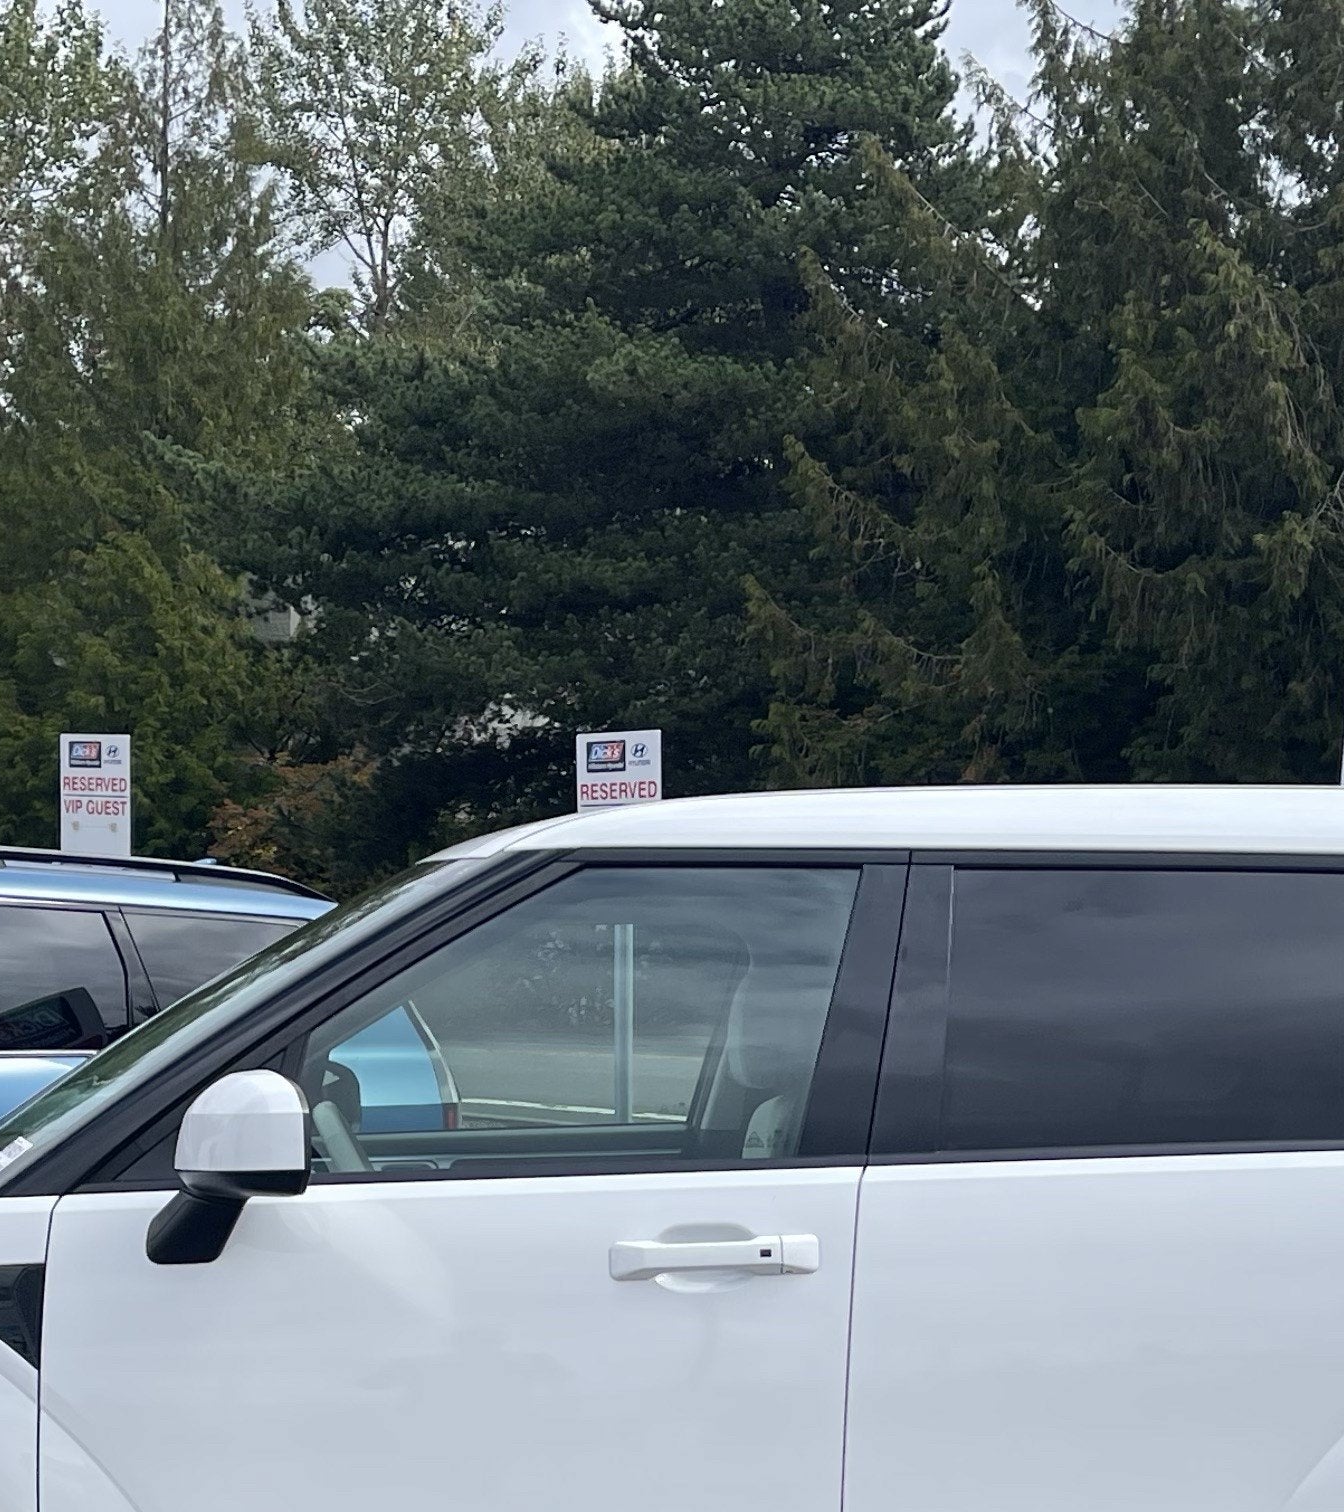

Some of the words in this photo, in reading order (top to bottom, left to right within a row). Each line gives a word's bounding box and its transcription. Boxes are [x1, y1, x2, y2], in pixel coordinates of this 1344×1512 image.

[63, 776, 127, 793] RESERVED
[580, 780, 657, 801] RESERVED
[64, 799, 82, 814] VIP
[86, 800, 127, 816] GUEST
